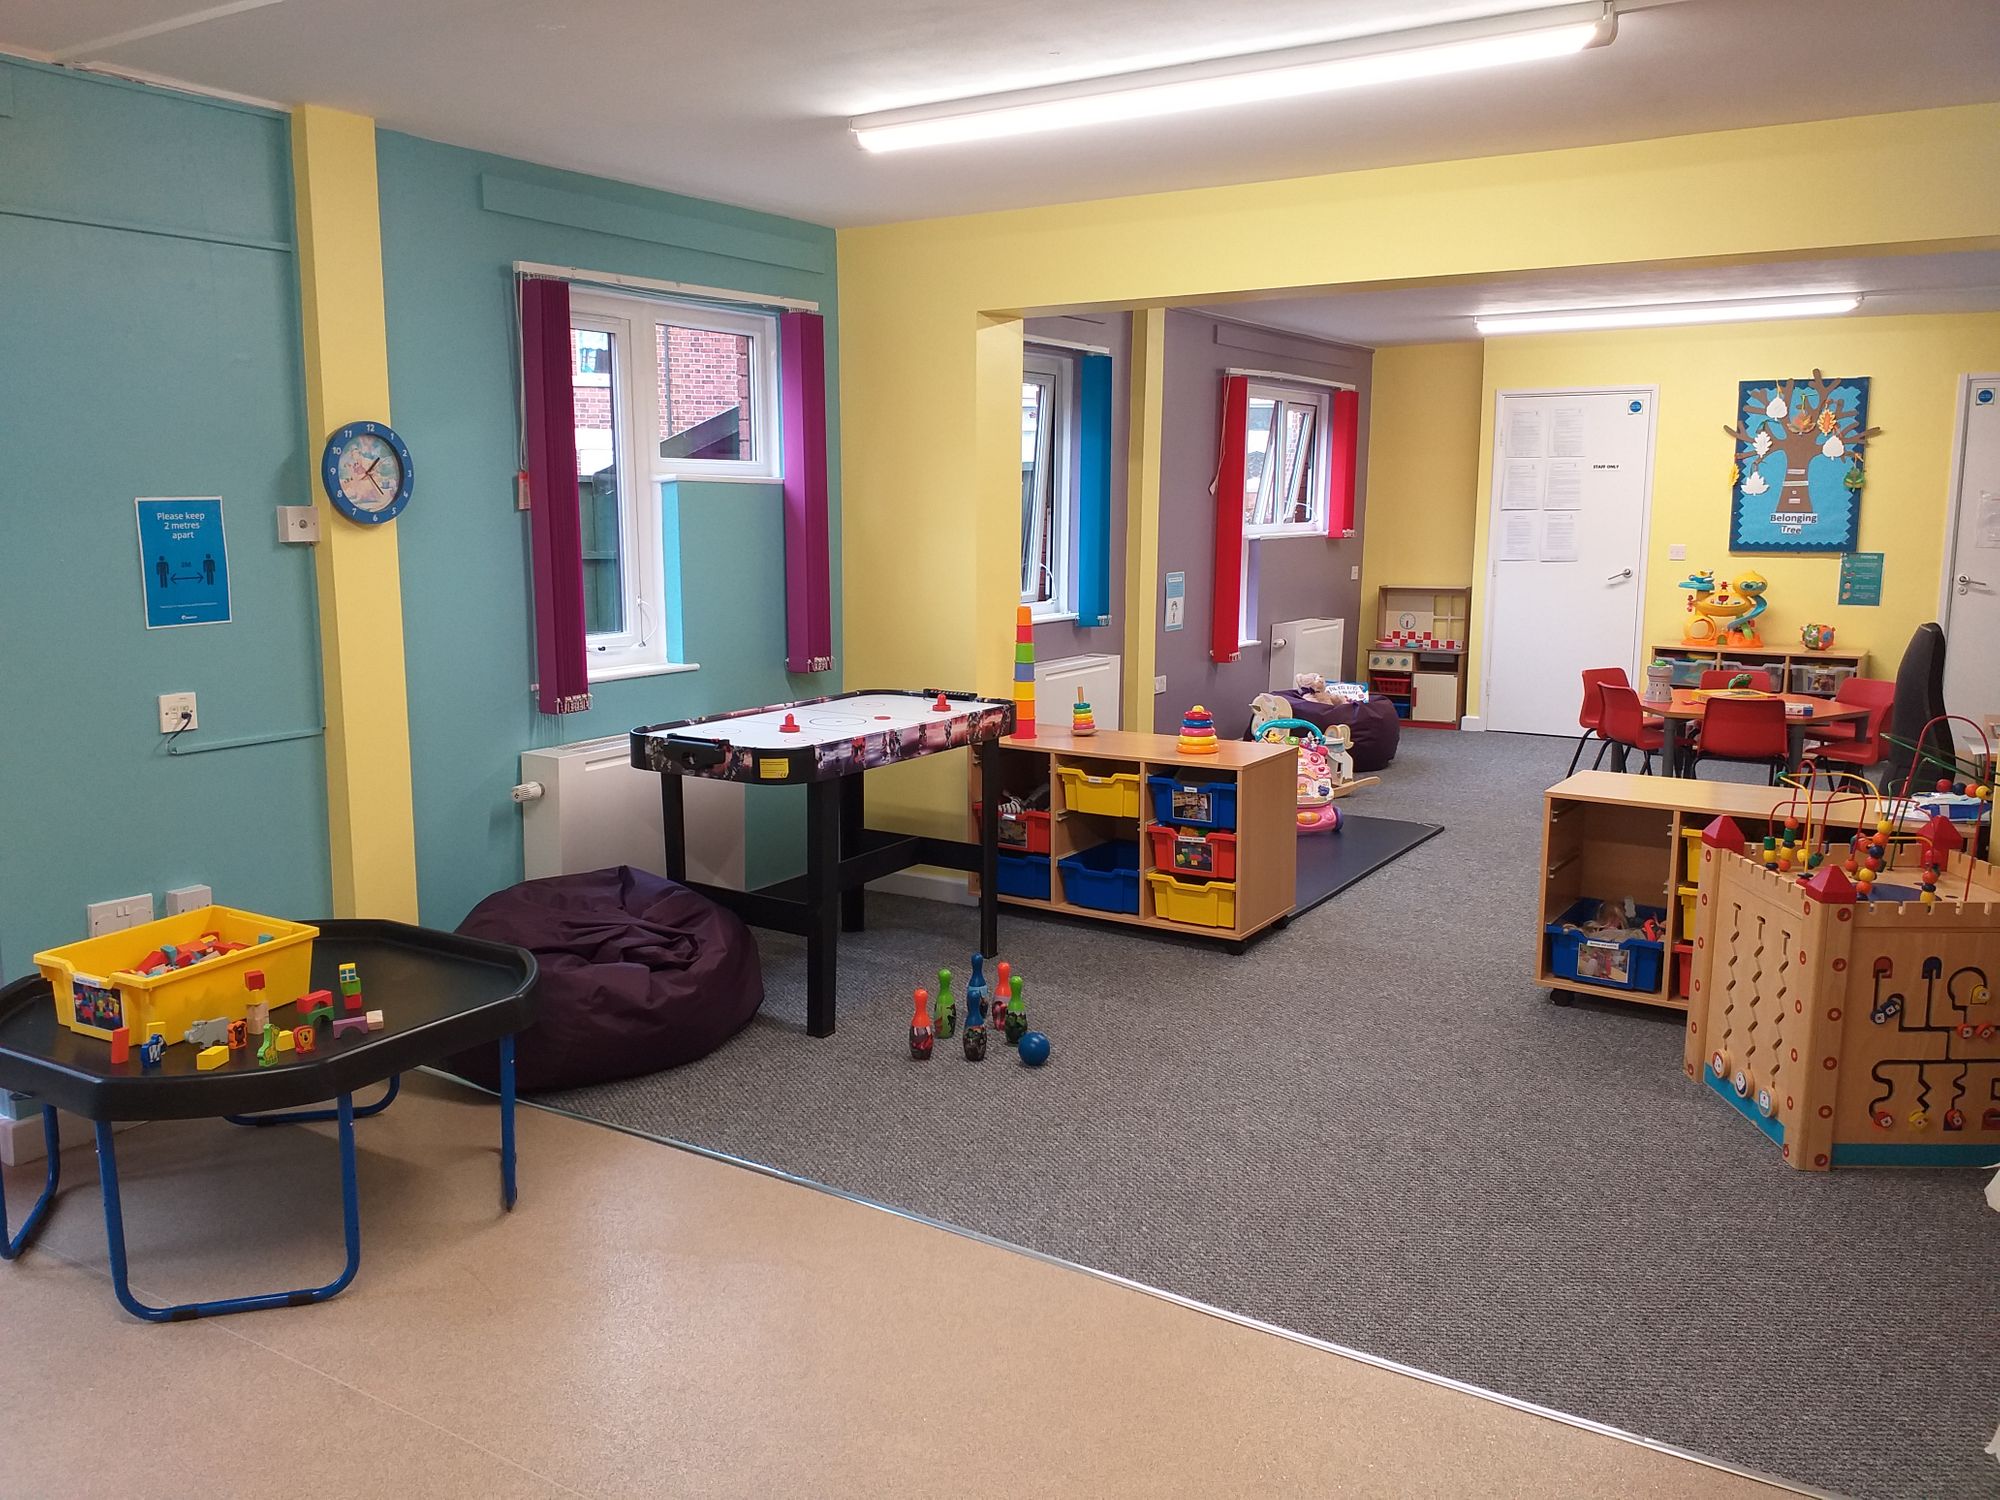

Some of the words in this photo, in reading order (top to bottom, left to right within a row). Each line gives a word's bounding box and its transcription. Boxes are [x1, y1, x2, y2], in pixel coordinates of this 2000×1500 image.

[366, 424, 375, 432] 12
[344, 430, 352, 438] 11
[332, 447, 341, 455] 10
[330, 467, 336, 475] 9
[352, 508, 357, 516] 7
[156, 512, 184, 520] Please
[185, 512, 205, 521] keep
[1770, 514, 1817, 523] Belonging
[164, 522, 170, 530] 2
[171, 522, 200, 530] metres
[1782, 525, 1801, 534] Tree
[172, 532, 194, 540] apart
